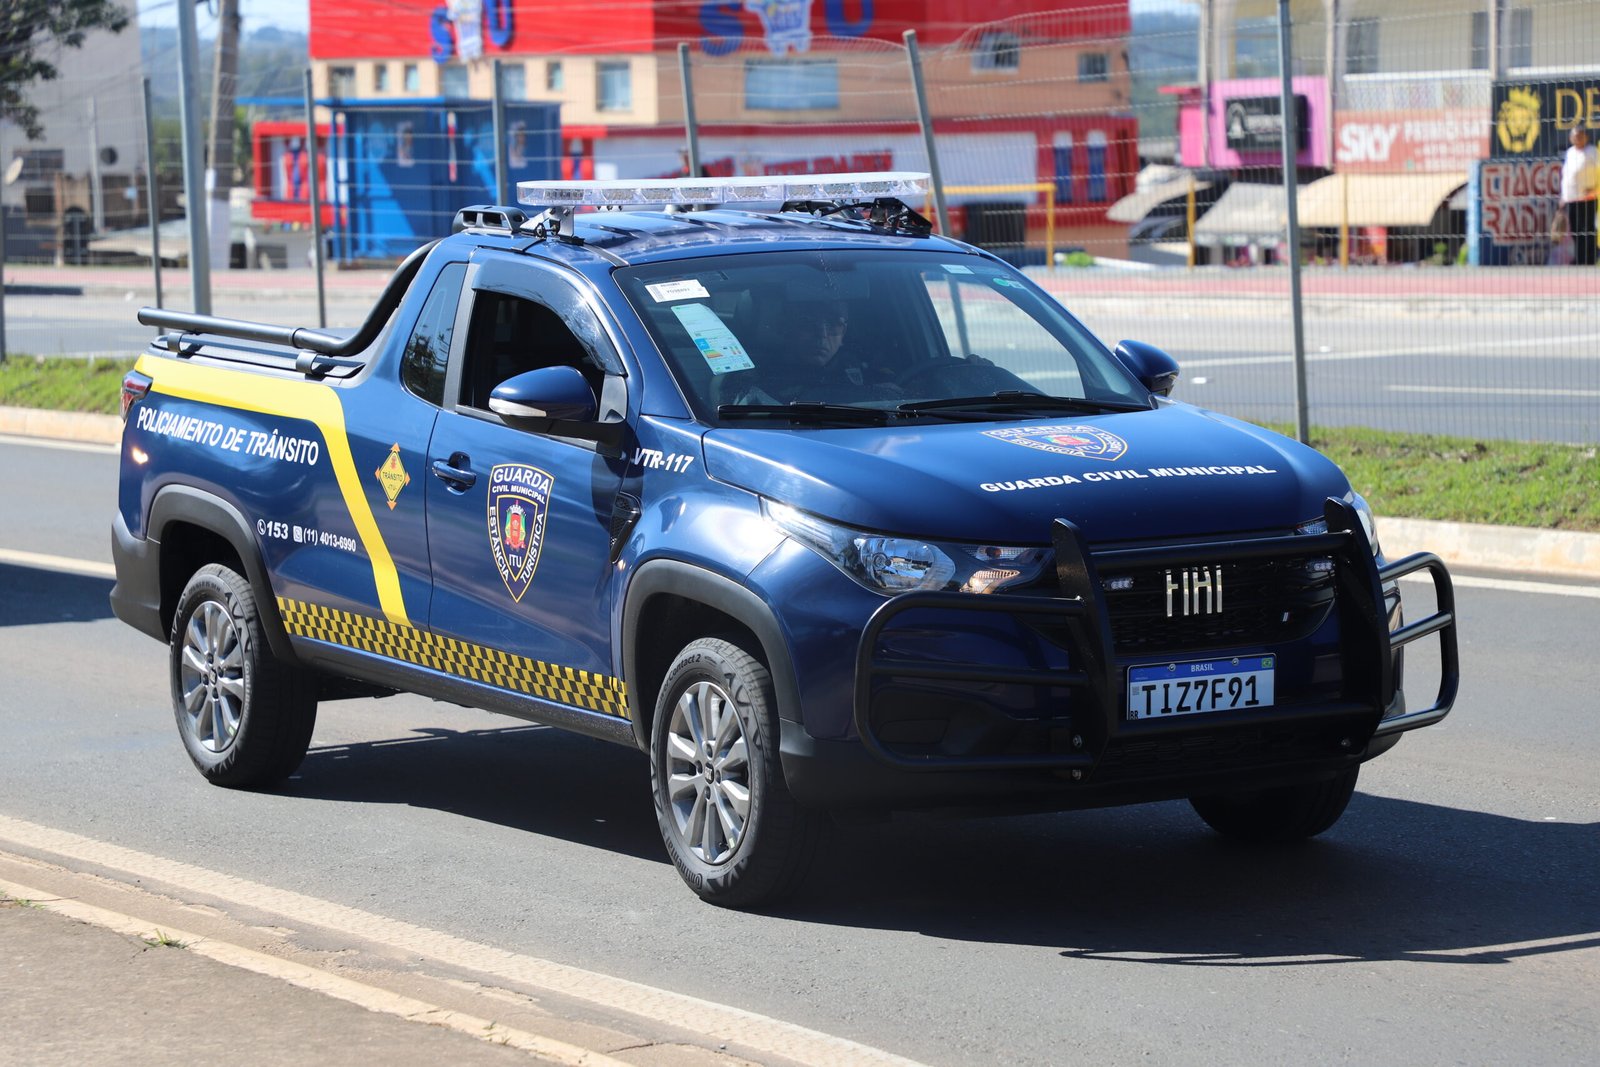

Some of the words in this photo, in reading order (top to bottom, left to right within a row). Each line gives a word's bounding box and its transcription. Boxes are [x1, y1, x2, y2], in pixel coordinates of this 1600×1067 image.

[1337, 121, 1398, 163] SKY
[138, 407, 221, 446] POLICIAMENTO
[221, 427, 246, 452] DE
[245, 429, 319, 466] TRÂNSITO
[633, 447, 694, 473] VTR-117
[493, 468, 550, 495] GUARDA
[979, 474, 1082, 493] GUARDA
[1083, 468, 1149, 483] CIVIL
[1148, 464, 1278, 478] MUNICIPAL
[492, 485, 509, 494] CIVIL
[510, 485, 546, 505] MUNICIPAL
[266, 520, 289, 539] 153
[303, 529, 318, 545] (11)
[319, 532, 356, 552] 4013-6990
[508, 553, 522, 568] ITU
[695, 653, 702, 663] 2
[1190, 663, 1214, 673] BRASIL
[1142, 675, 1260, 716] TIZ7F91
